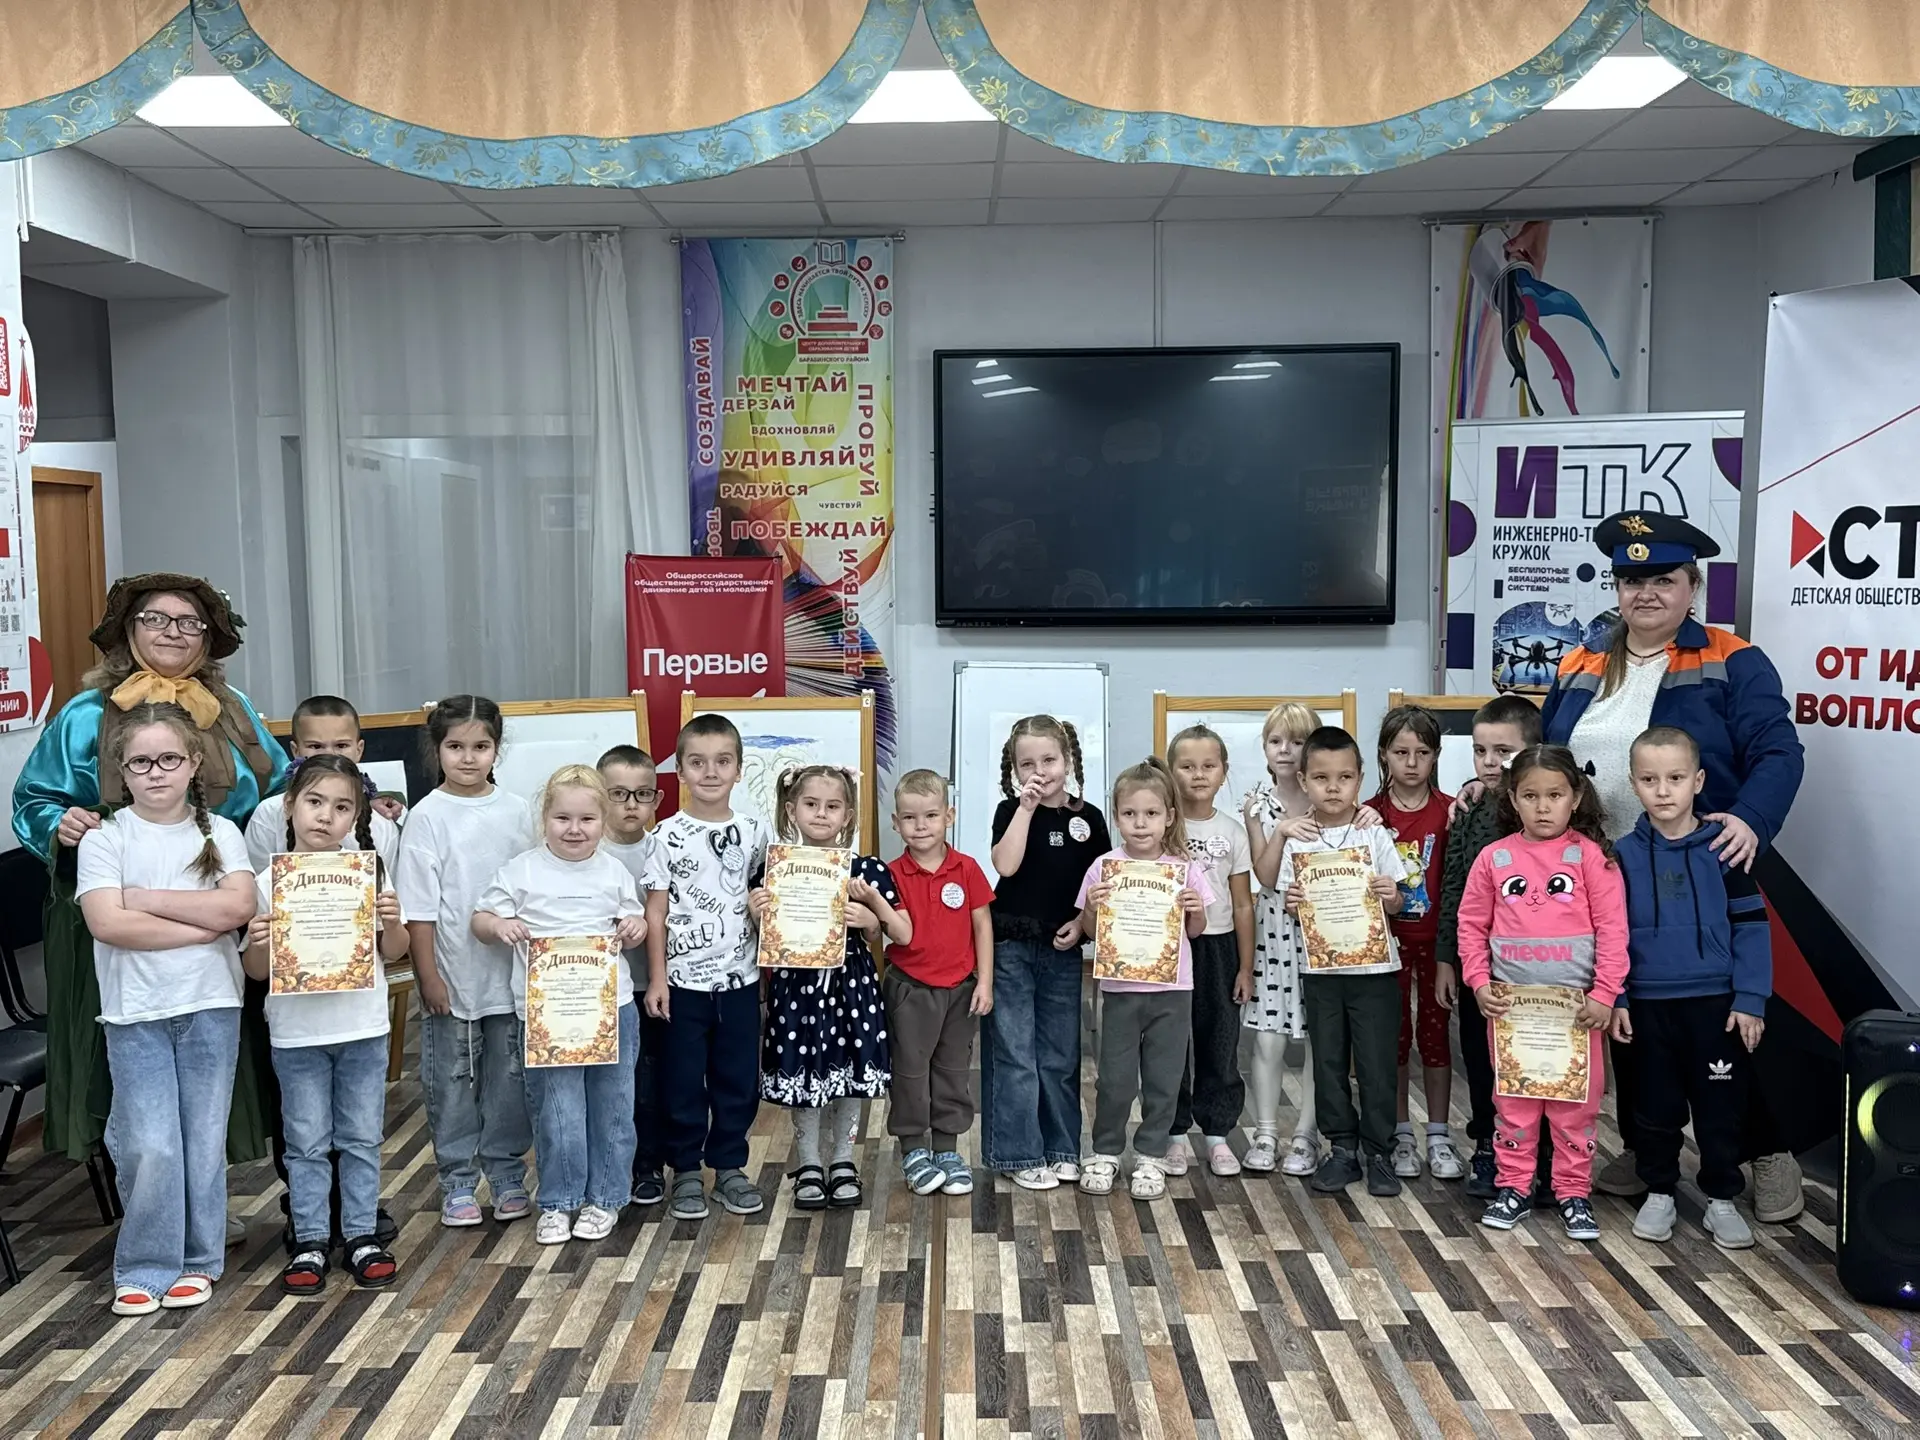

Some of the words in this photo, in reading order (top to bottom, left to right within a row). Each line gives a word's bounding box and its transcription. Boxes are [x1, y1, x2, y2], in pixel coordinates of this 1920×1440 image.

[738, 372, 847, 393] МЕЧТАЙ
[692, 338, 715, 464] СОЗДАВАЙ
[722, 396, 795, 413] ДЕРЗАЙ
[751, 424, 835, 435] ВДОХНОВЛЯЙ
[858, 384, 879, 496] ПРОБУЙ
[724, 446, 855, 469] УДИВЛЯЙ
[1494, 442, 1692, 519] ИТК
[722, 481, 808, 498] РАДУЙСЯ
[818, 500, 862, 509] ЧУВСТВУЙ
[732, 516, 886, 540] ПОБЕЖДАЙ
[1828, 505, 1920, 580] СТ
[1492, 544, 1551, 561] КРУЖОК
[665, 572, 744, 580] Общероссийское
[1508, 566, 1569, 575] БЕСПИЛОТНЫЕ
[700, 579, 774, 587] государственное
[1508, 575, 1570, 584] АВИАЦИОННЫЕ
[1508, 584, 1550, 592] СИСТЕМЫ
[688, 586, 714, 594] детей
[1791, 587, 1851, 606] ДЕТСКАЯ
[1855, 587, 1920, 607] ОБЩЕСТВ
[839, 549, 864, 678] ДЕЙСТВУЙ
[643, 648, 768, 684] Первые
[1815, 646, 1868, 680] ОТ
[1795, 692, 1920, 734] ВОПЛО
[783, 862, 832, 879] Диплом
[1309, 867, 1357, 883] Диплом
[294, 872, 354, 892] Диплом
[1117, 876, 1167, 893] Диплом
[686, 884, 726, 914] URBAN
[546, 954, 600, 971] Диплом
[1511, 996, 1566, 1009] Диплом
